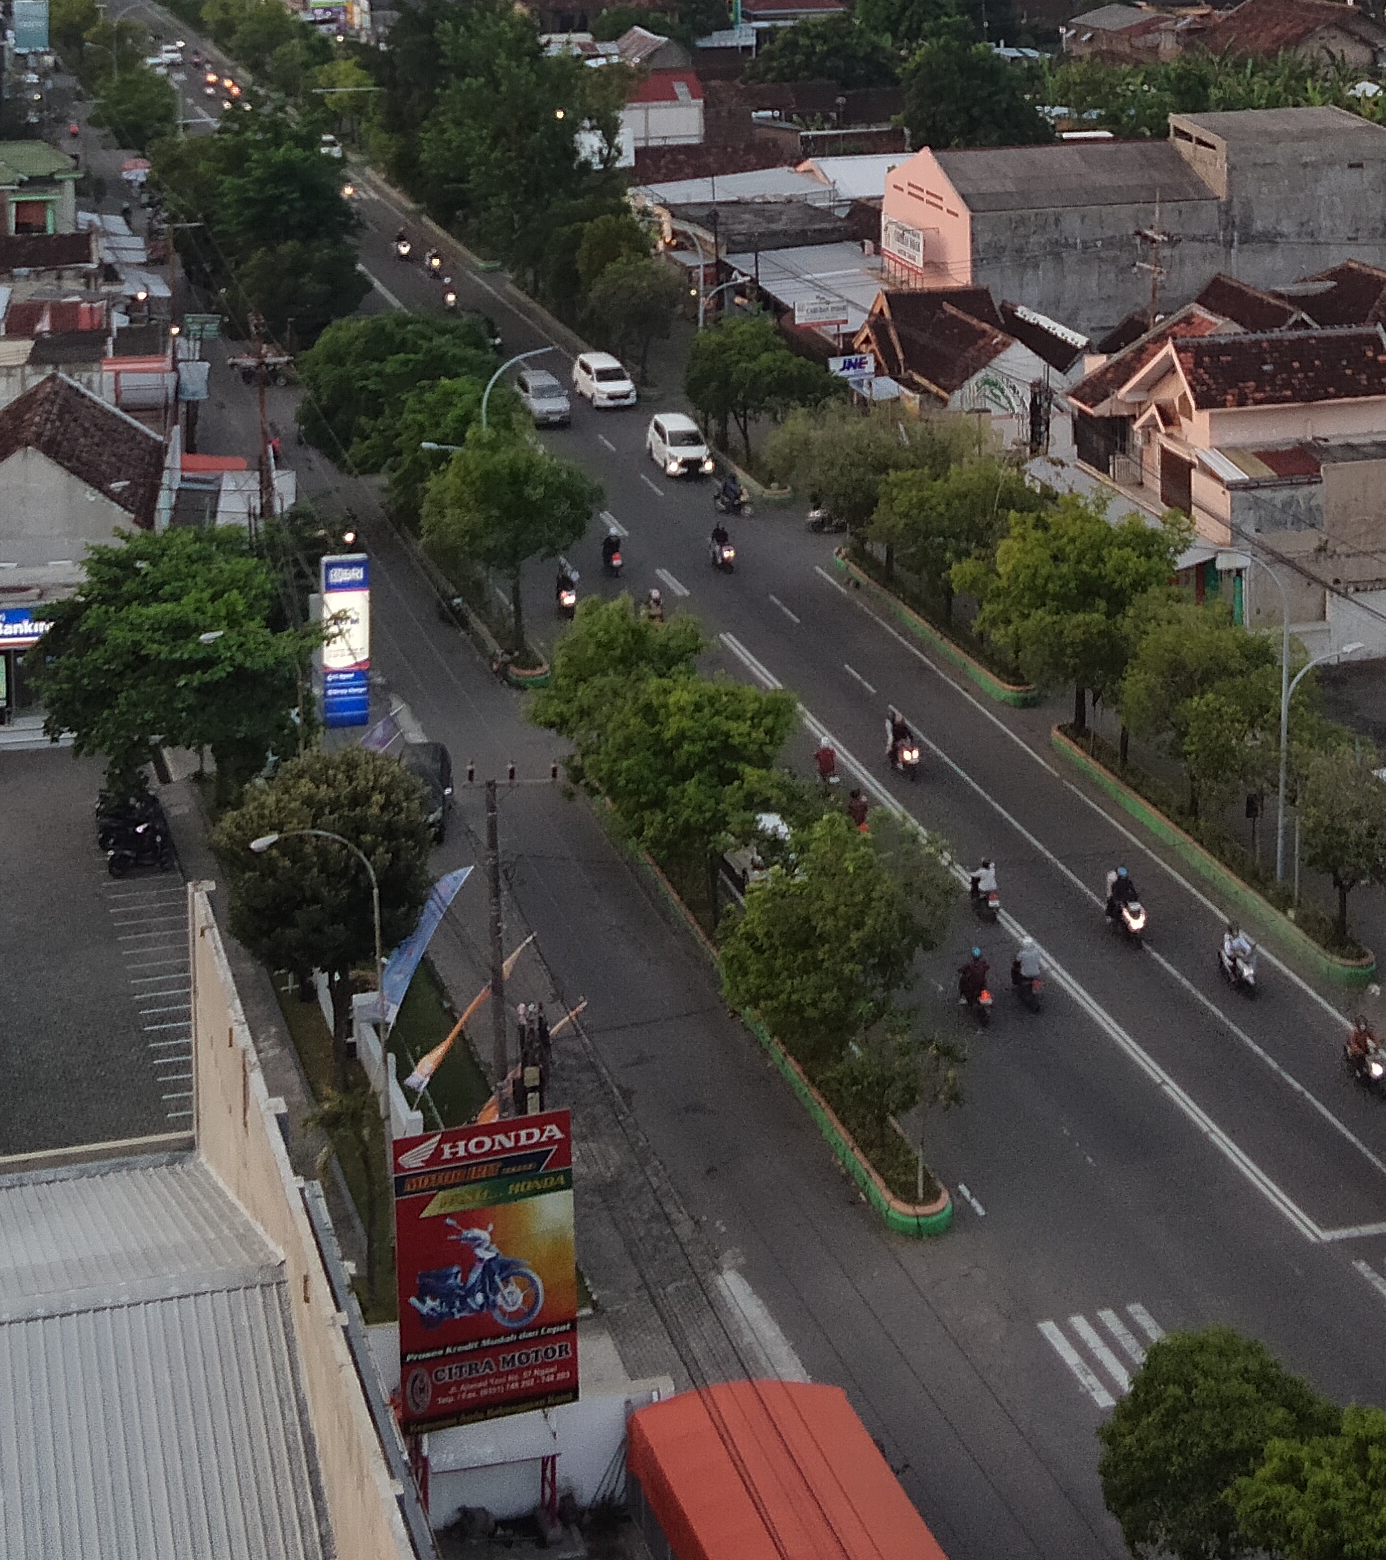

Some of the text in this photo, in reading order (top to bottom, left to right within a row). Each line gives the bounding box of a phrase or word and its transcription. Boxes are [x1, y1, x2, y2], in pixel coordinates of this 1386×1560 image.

[839, 356, 869, 371] JNE
[440, 1124, 565, 1160] HONDA
[508, 1174, 567, 1195] HONDA
[444, 1340, 480, 1356] Kredit
[481, 1334, 517, 1348] Mudah
[518, 1329, 539, 1340] dan
[432, 1341, 572, 1383] CITRA MOTOR
